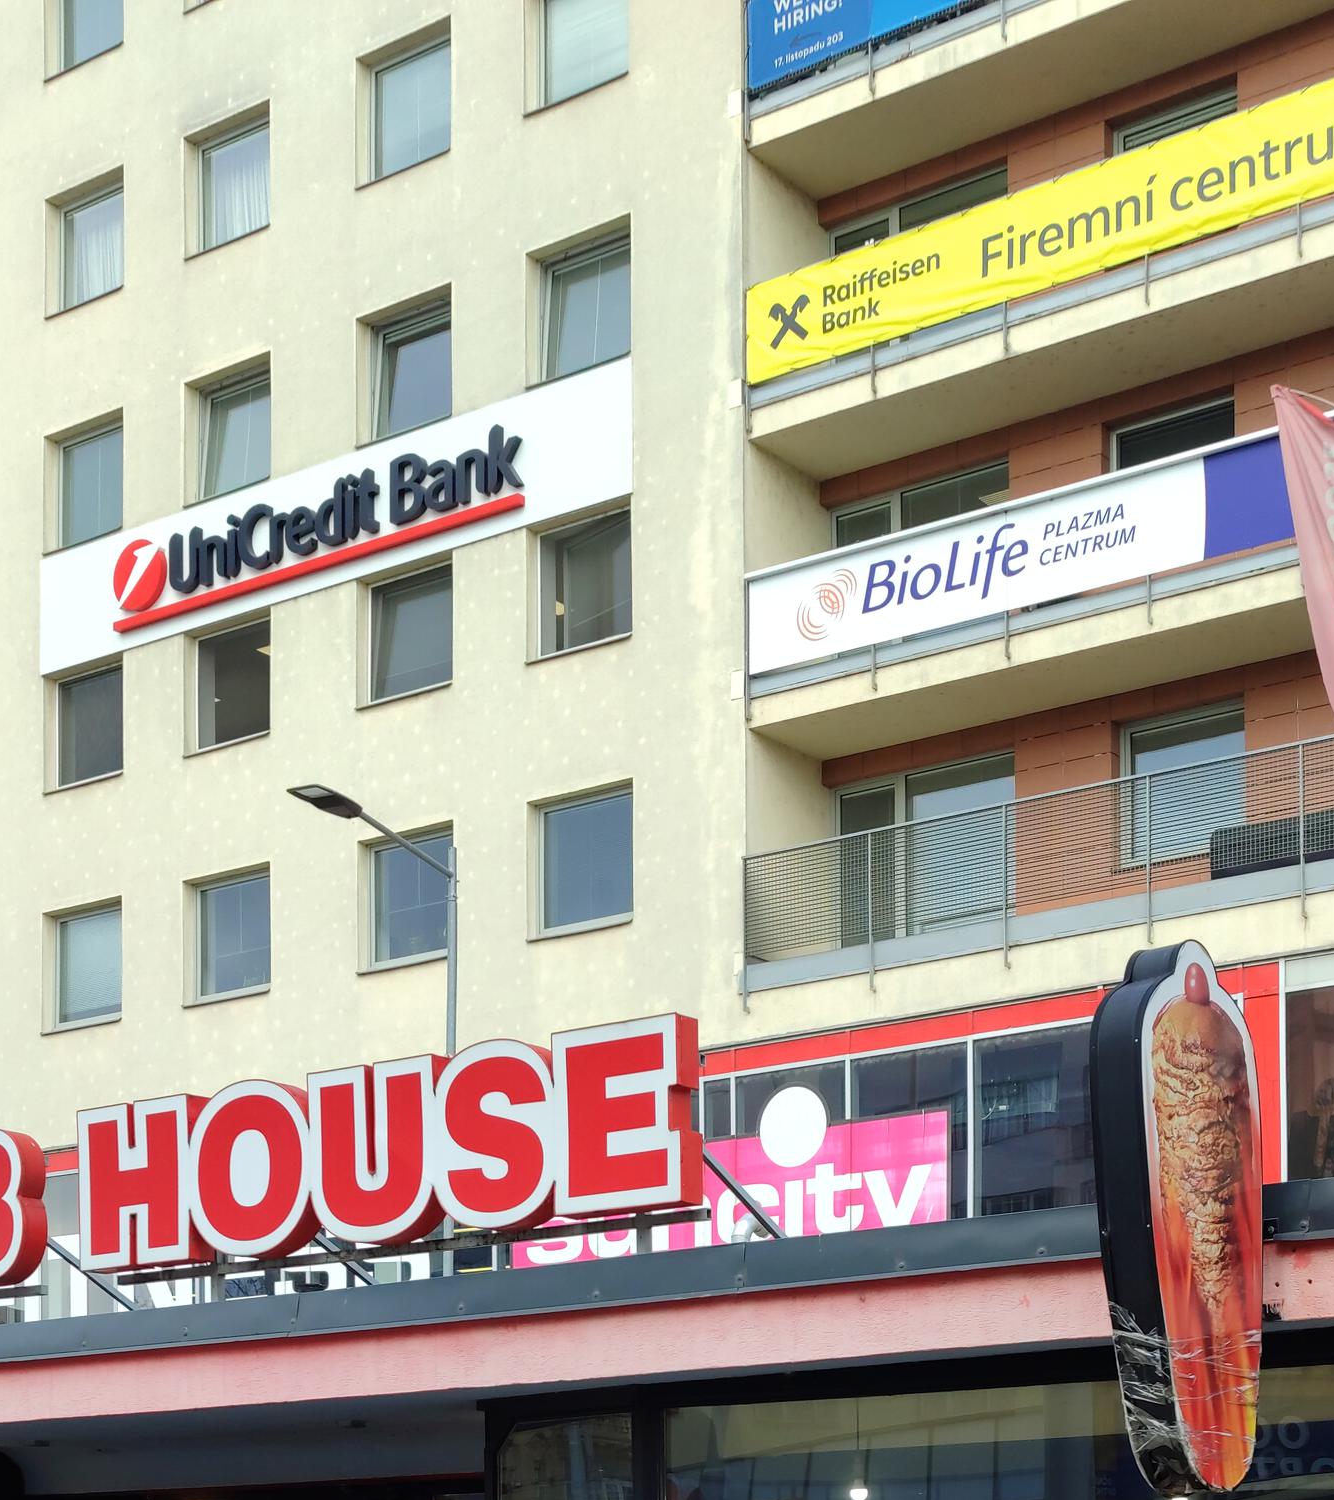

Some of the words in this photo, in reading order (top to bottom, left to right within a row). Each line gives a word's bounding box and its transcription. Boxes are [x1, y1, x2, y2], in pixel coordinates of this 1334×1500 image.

[774, 0, 843, 35] HIRING!
[786, 41, 825, 63] listopadu
[981, 174, 1155, 279] Firemní
[822, 250, 941, 305] Raiffeisen
[822, 297, 880, 334] Bank
[169, 467, 380, 593] UniCredit
[390, 424, 524, 527] Bank
[1043, 503, 1126, 540] PLAZMA
[862, 523, 1029, 615] BioLife
[1039, 525, 1137, 567] CENTRUM
[78, 1013, 703, 1270] HOUSE
